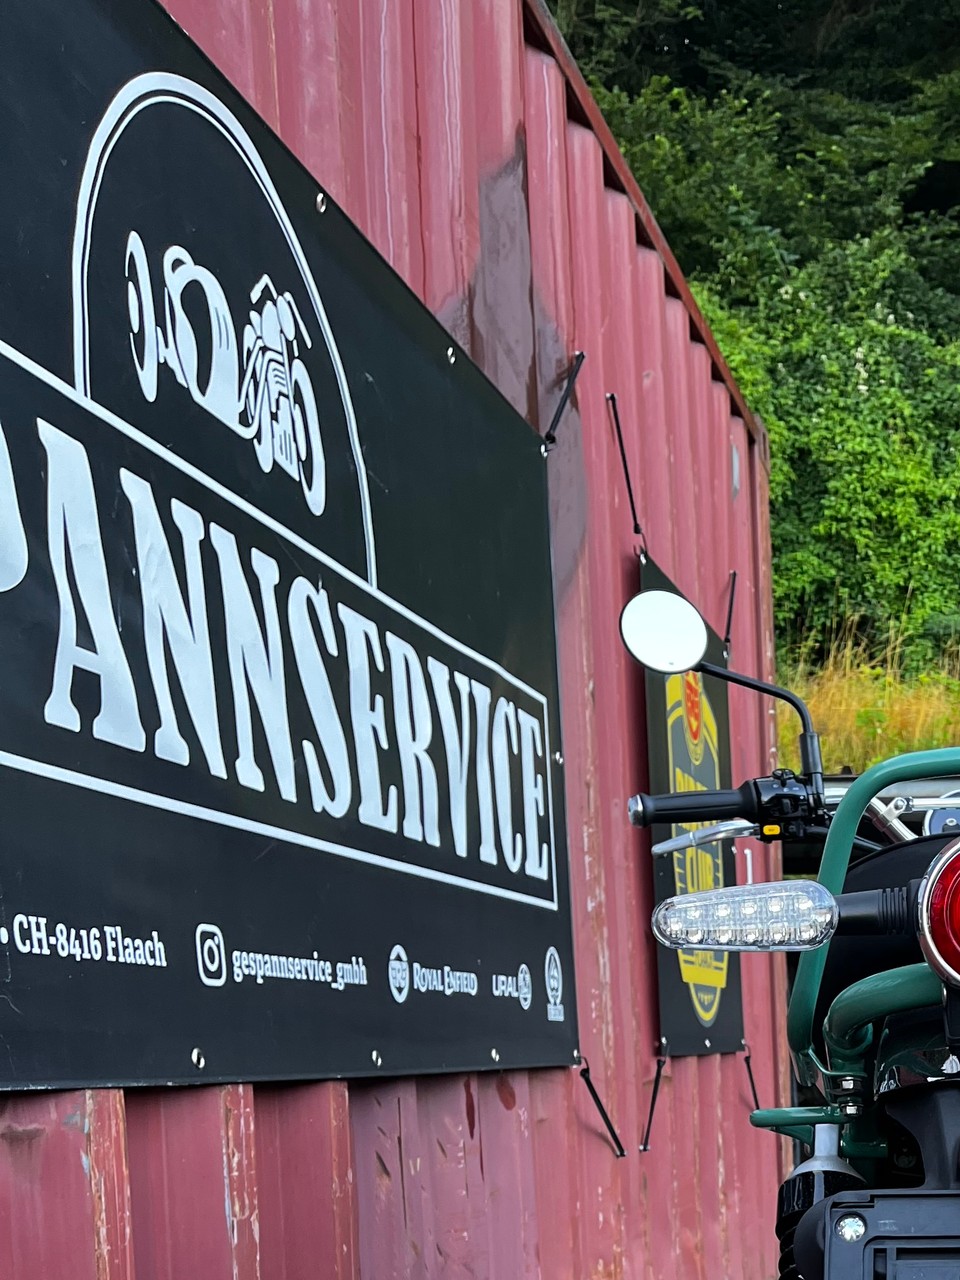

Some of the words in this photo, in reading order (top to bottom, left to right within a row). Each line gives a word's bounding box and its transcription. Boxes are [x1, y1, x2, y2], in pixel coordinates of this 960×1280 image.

[13, 913, 102, 961] CH-8416
[103, 925, 168, 967] Flaach
[231, 950, 368, 991] gespannservice_gmbh
[413, 962, 443, 993] ROYAL
[444, 966, 478, 996] ENFIELD
[492, 974, 518, 998] URAL
